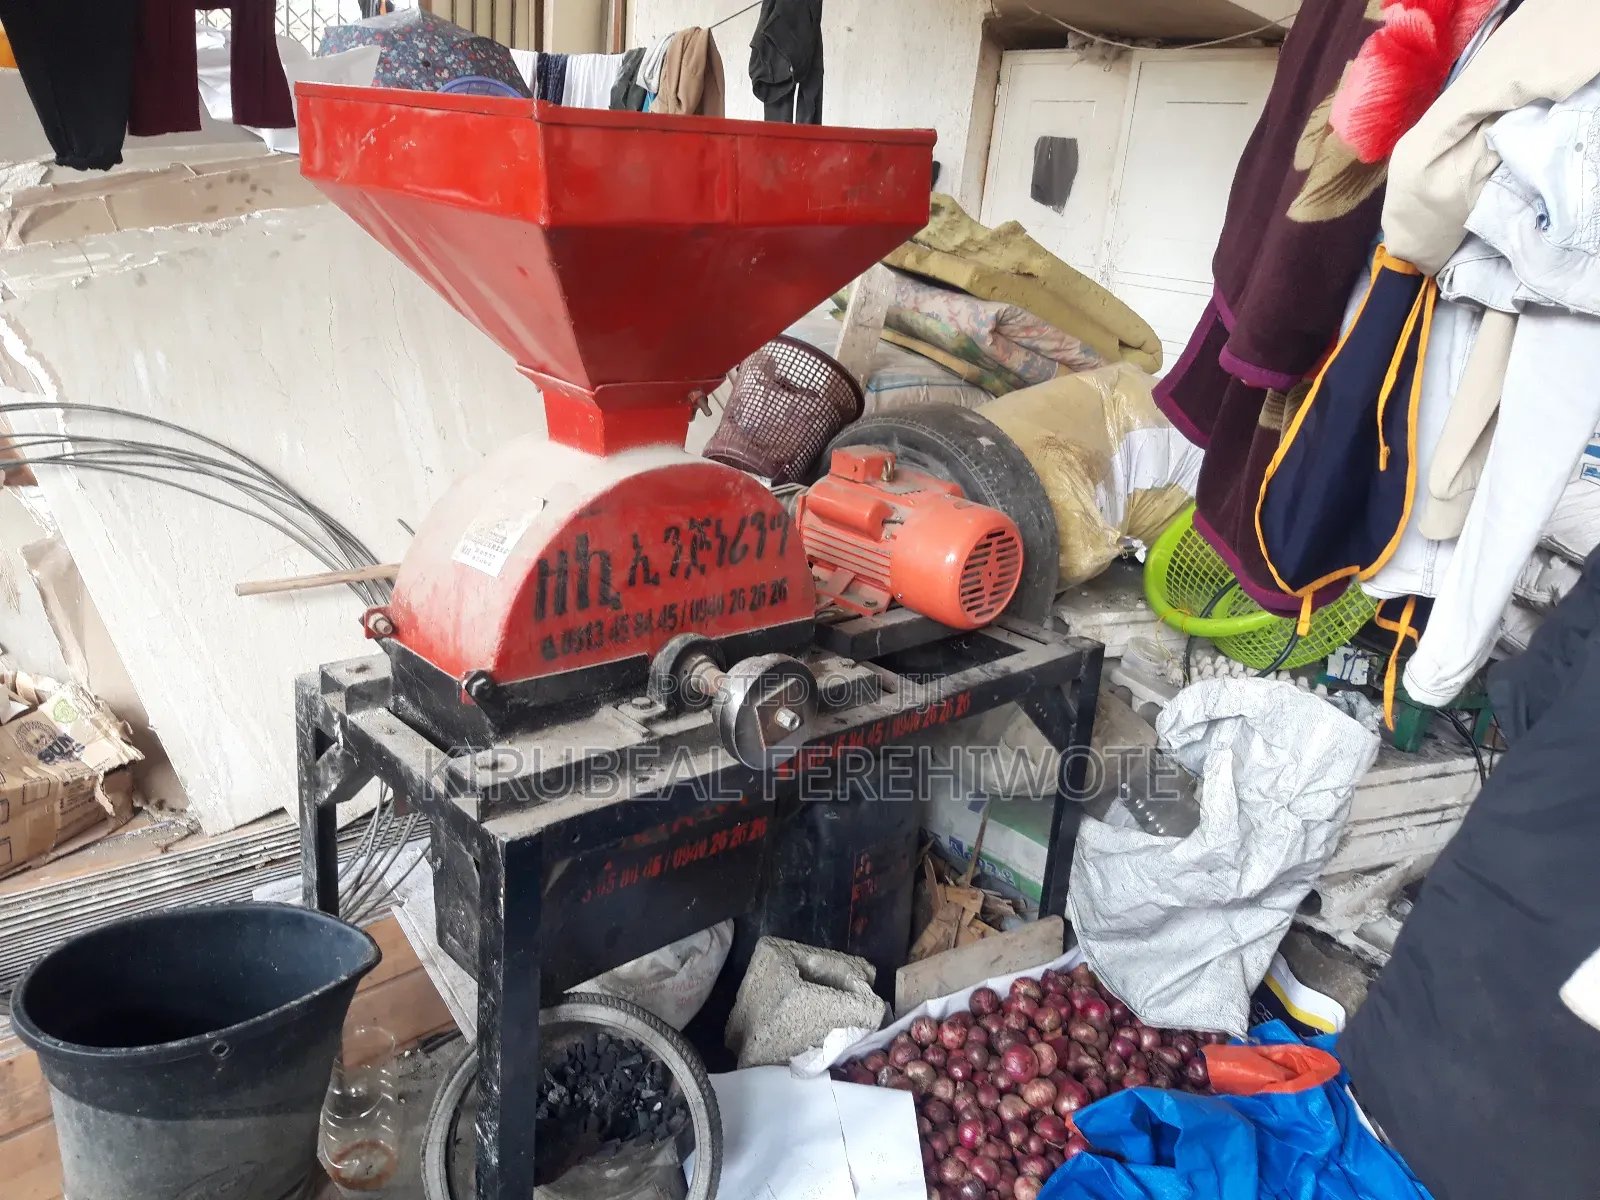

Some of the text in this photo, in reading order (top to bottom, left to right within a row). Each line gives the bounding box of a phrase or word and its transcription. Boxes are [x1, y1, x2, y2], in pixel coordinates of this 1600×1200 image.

[534, 532, 622, 621] ዘኪ
[658, 602, 679, 633] 45
[729, 587, 746, 616] 26
[749, 582, 767, 611] 26
[769, 576, 789, 605] 26
[955, 691, 972, 718] 26
[749, 816, 768, 842] 26
